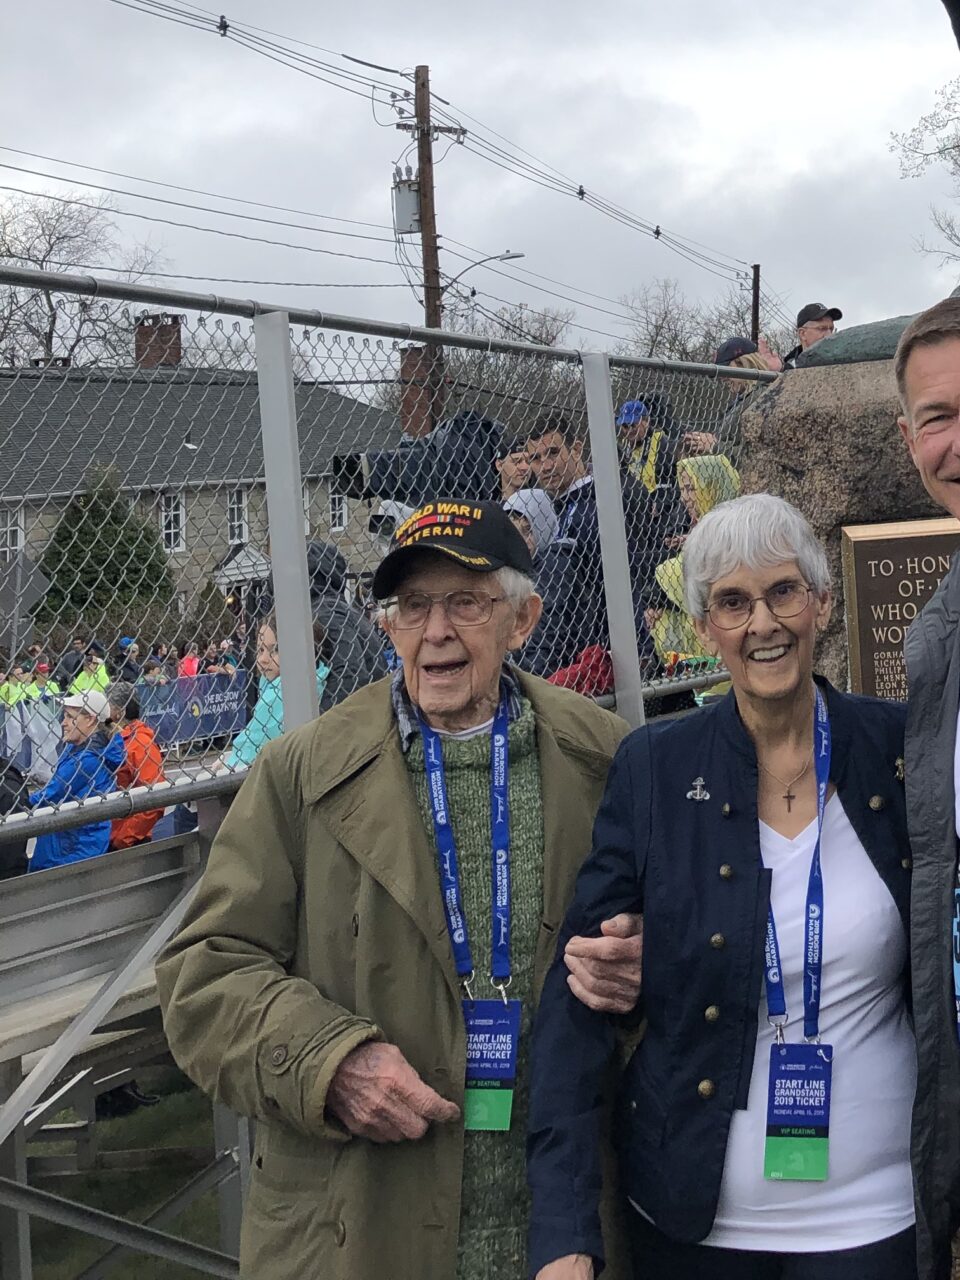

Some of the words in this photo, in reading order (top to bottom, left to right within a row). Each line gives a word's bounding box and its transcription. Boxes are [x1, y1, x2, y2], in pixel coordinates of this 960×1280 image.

[437, 503, 470, 516] WAR
[473, 508, 482, 520] II
[868, 560, 894, 577] TO
[898, 580, 925, 597] OF
[871, 602, 917, 621] WHO
[875, 666, 901, 675] PHILIP
[876, 681, 897, 689] LEON
[767, 922, 777, 967] MARATHON
[467, 1034, 490, 1043] TART
[491, 1034, 512, 1043] LINE
[467, 1051, 480, 1059] 019
[482, 1051, 511, 1059] TICKET
[775, 1080, 803, 1089] START
[804, 1080, 826, 1089] LINE
[774, 1089, 826, 1097] GRANDSTAND
[774, 1097, 794, 1105] 2019
[795, 1097, 825, 1106] TICKET
